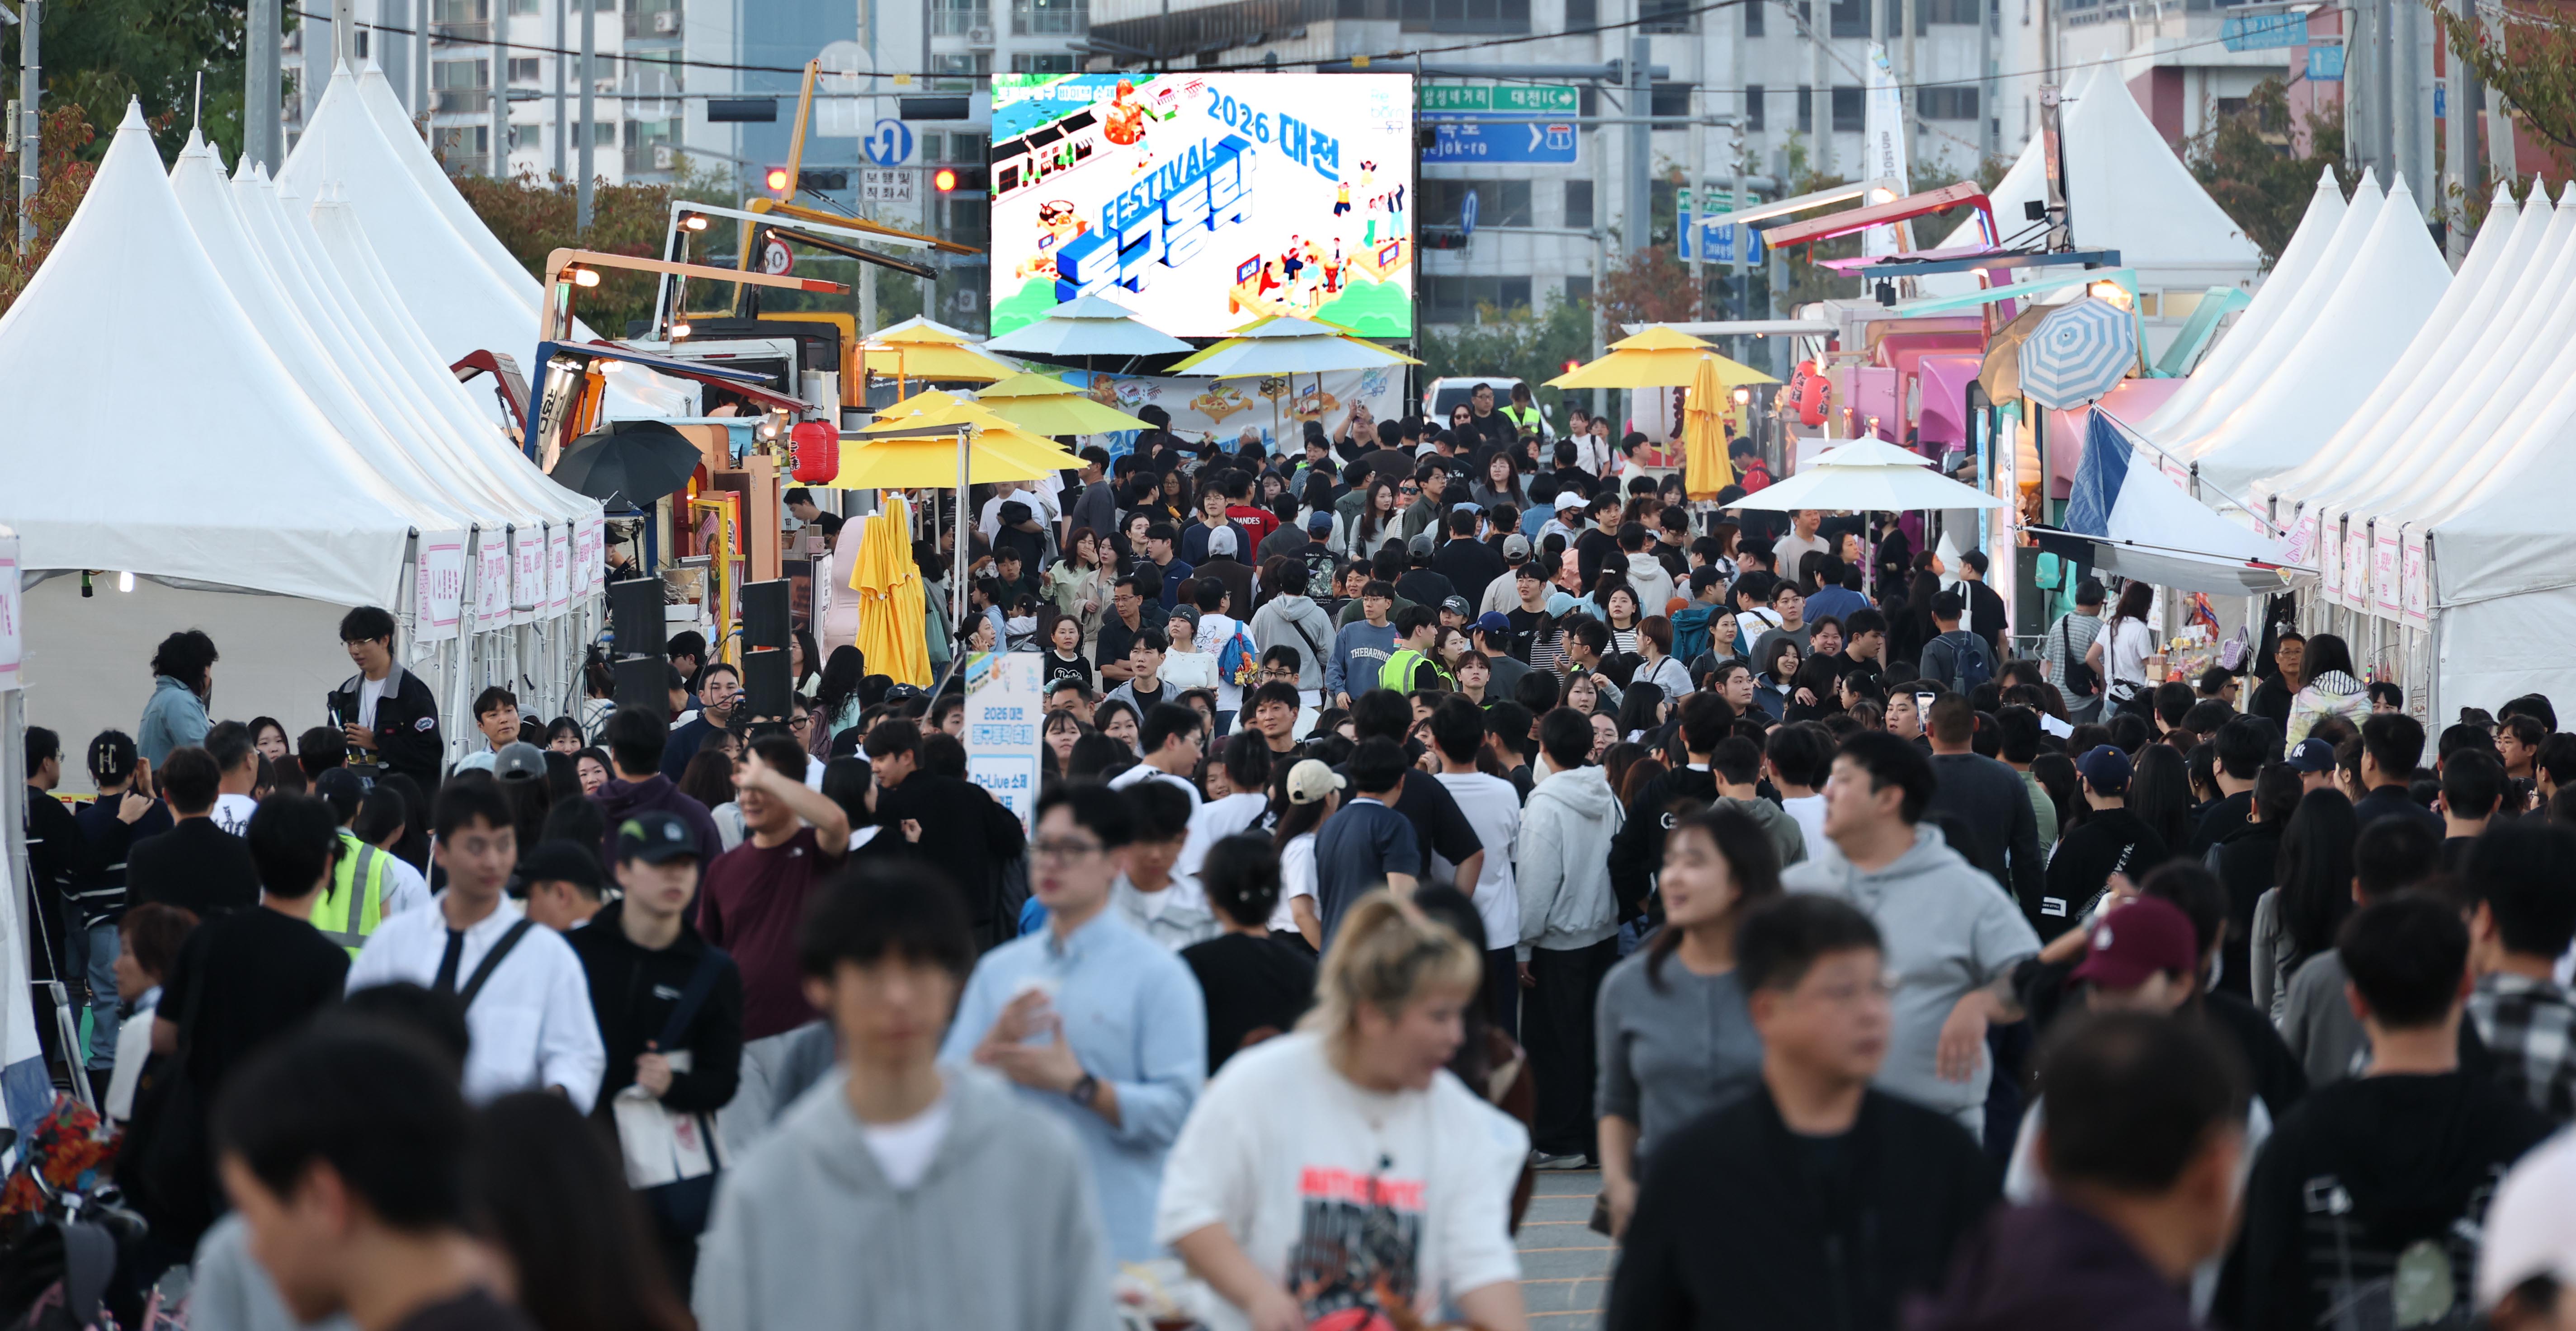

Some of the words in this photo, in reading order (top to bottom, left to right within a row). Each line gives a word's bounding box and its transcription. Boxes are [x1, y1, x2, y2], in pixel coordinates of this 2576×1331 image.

[1511, 90, 1556, 107] 대전IC
[1207, 87, 1269, 143] 2026
[1279, 113, 1339, 182] 대전
[1099, 136, 1216, 238] FESTIVAL
[1056, 134, 1256, 304] 동구동락
[984, 707, 1007, 720] 2026
[1010, 707, 1023, 720] 대전
[973, 724, 1011, 744] 동구동락
[976, 774, 1009, 788] D-Live
[1012, 774, 1027, 788] 소제
